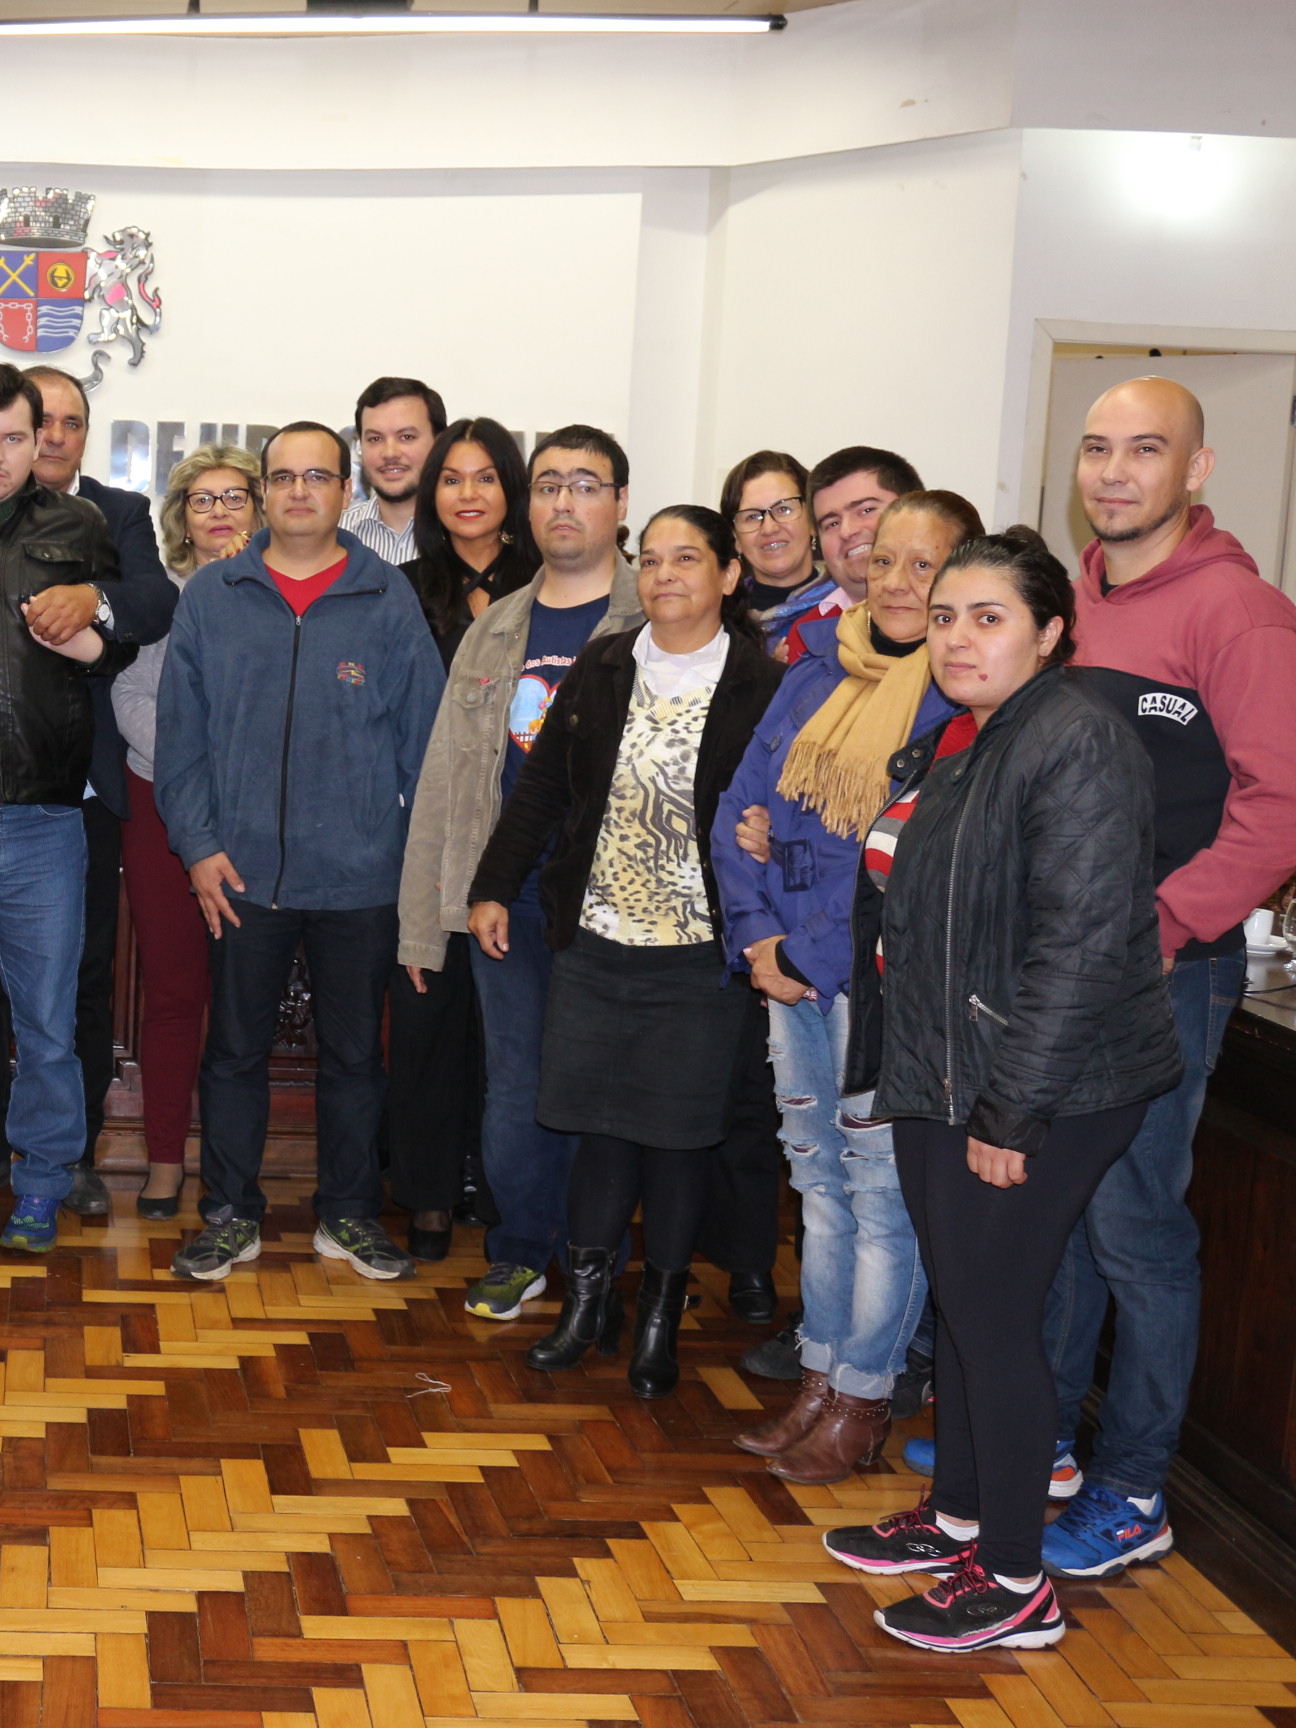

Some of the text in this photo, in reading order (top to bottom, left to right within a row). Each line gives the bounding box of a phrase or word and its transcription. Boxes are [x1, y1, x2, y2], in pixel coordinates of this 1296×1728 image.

[109, 419, 186, 496] DE
[1140, 695, 1195, 723] CASUAL
[1116, 1523, 1142, 1543] FILA
